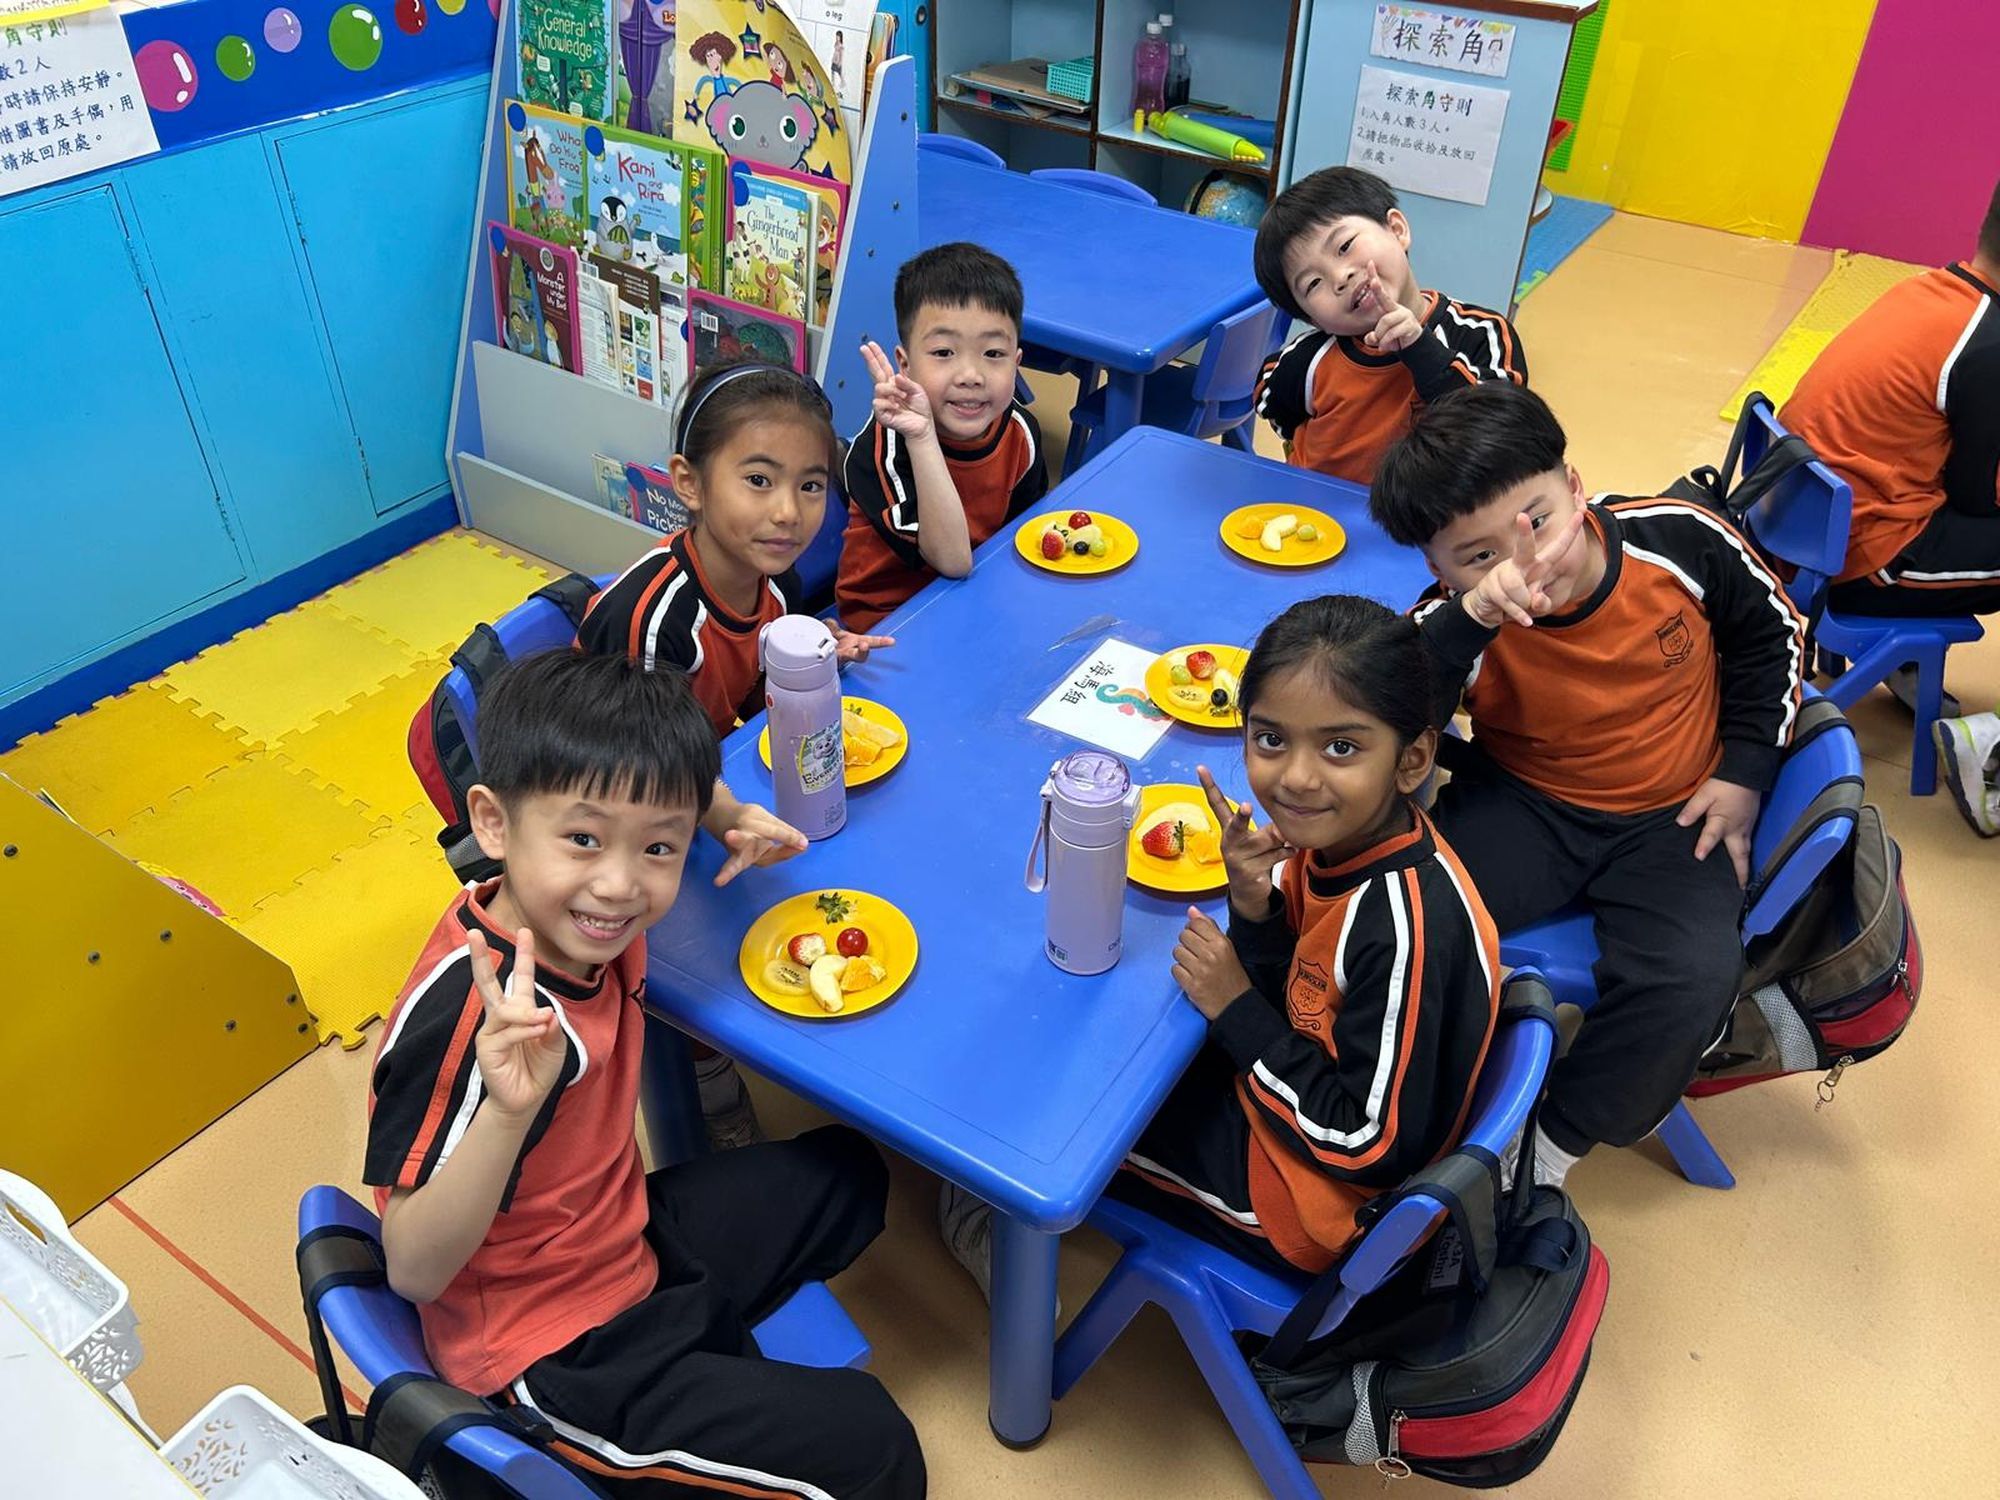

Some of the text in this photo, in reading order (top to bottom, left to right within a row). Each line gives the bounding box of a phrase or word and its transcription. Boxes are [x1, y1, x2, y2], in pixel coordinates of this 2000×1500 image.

[543, 8, 586, 38] General
[538, 25, 592, 62] Knowledge
[1393, 19, 1483, 65] 探索角
[0, 70, 123, 116] 時請保持安靜。
[1386, 82, 1473, 117] 探索角守則
[556, 129, 582, 147] Wha
[617, 151, 656, 183] Kami
[648, 181, 663, 191] and
[746, 210, 798, 242] Gingerbread
[764, 204, 775, 220] The
[769, 236, 789, 260] Man
[537, 271, 565, 293] Monster
[646, 488, 667, 506] No
[1060, 660, 1114, 704] 海馬組
